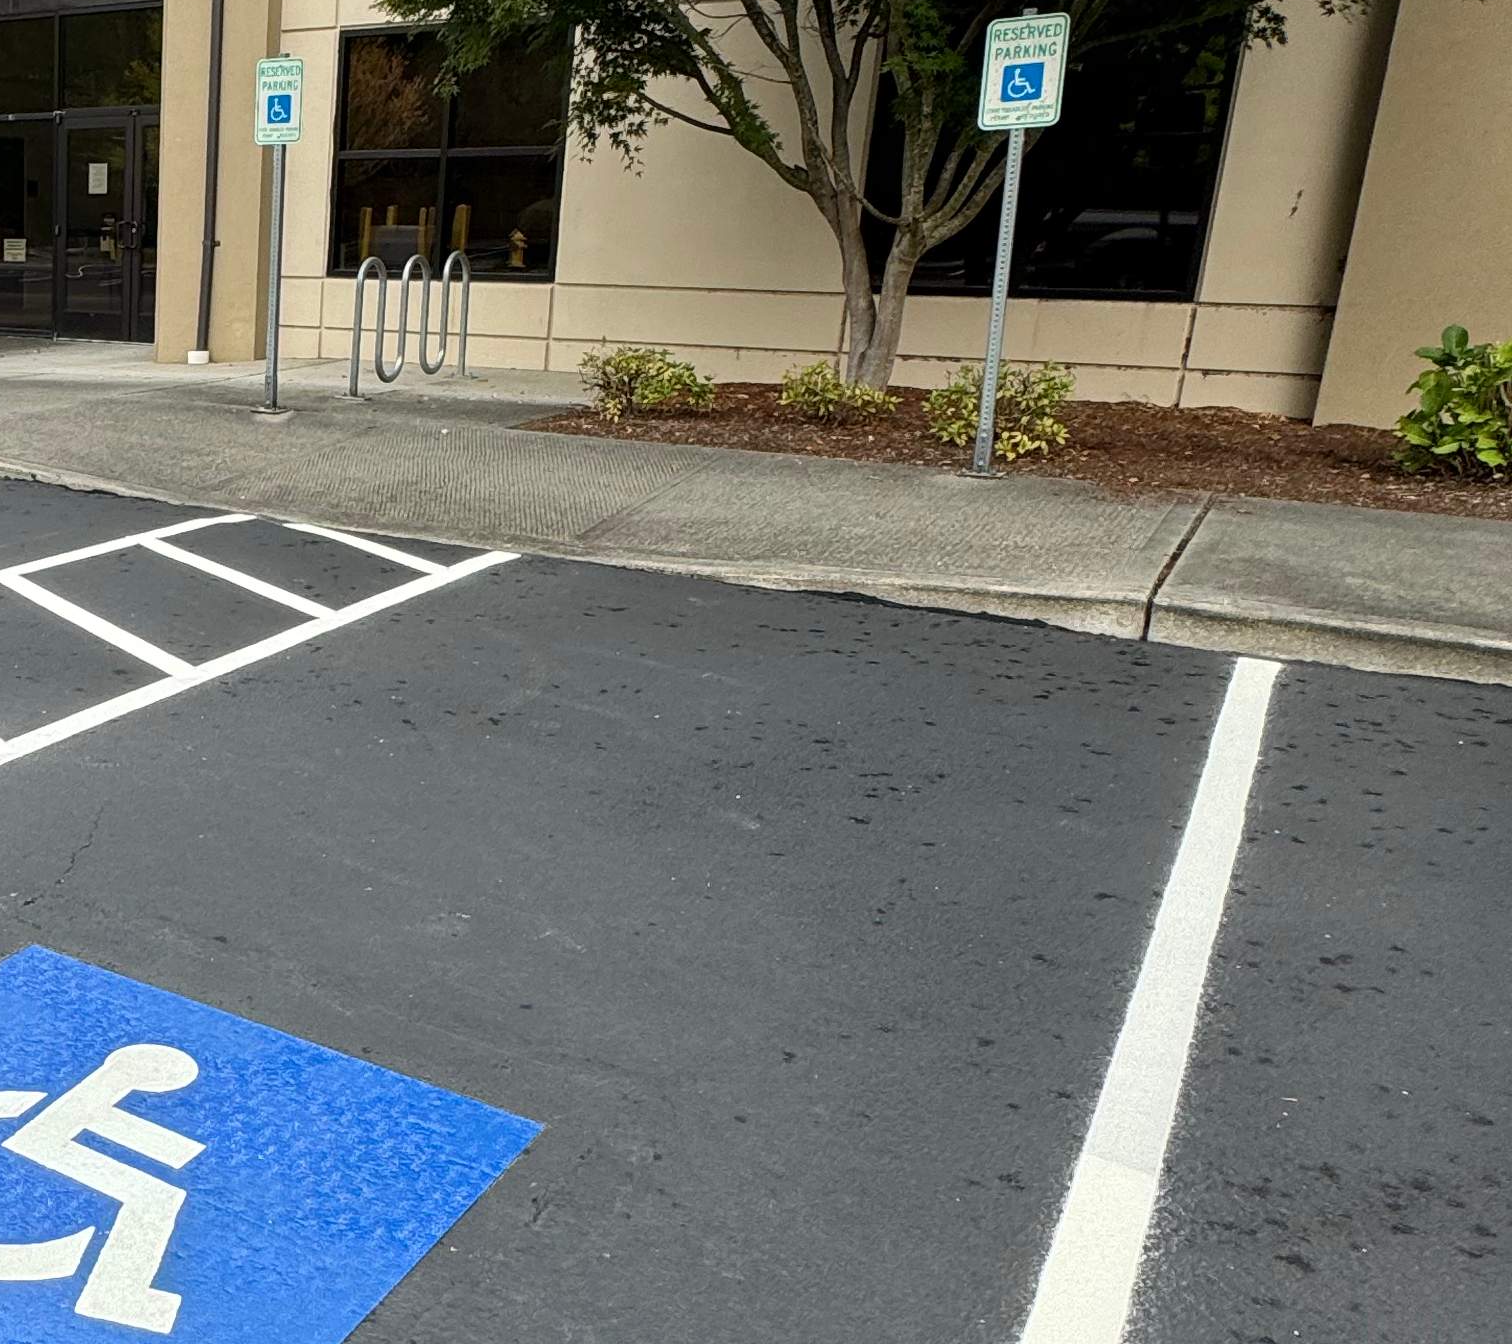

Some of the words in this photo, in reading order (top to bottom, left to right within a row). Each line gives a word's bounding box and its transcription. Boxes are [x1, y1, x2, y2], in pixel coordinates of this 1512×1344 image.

[993, 23, 1062, 43] RESERVED
[995, 41, 1057, 60] PARKING
[261, 65, 301, 77] RESERVED
[262, 80, 299, 91] PARKING
